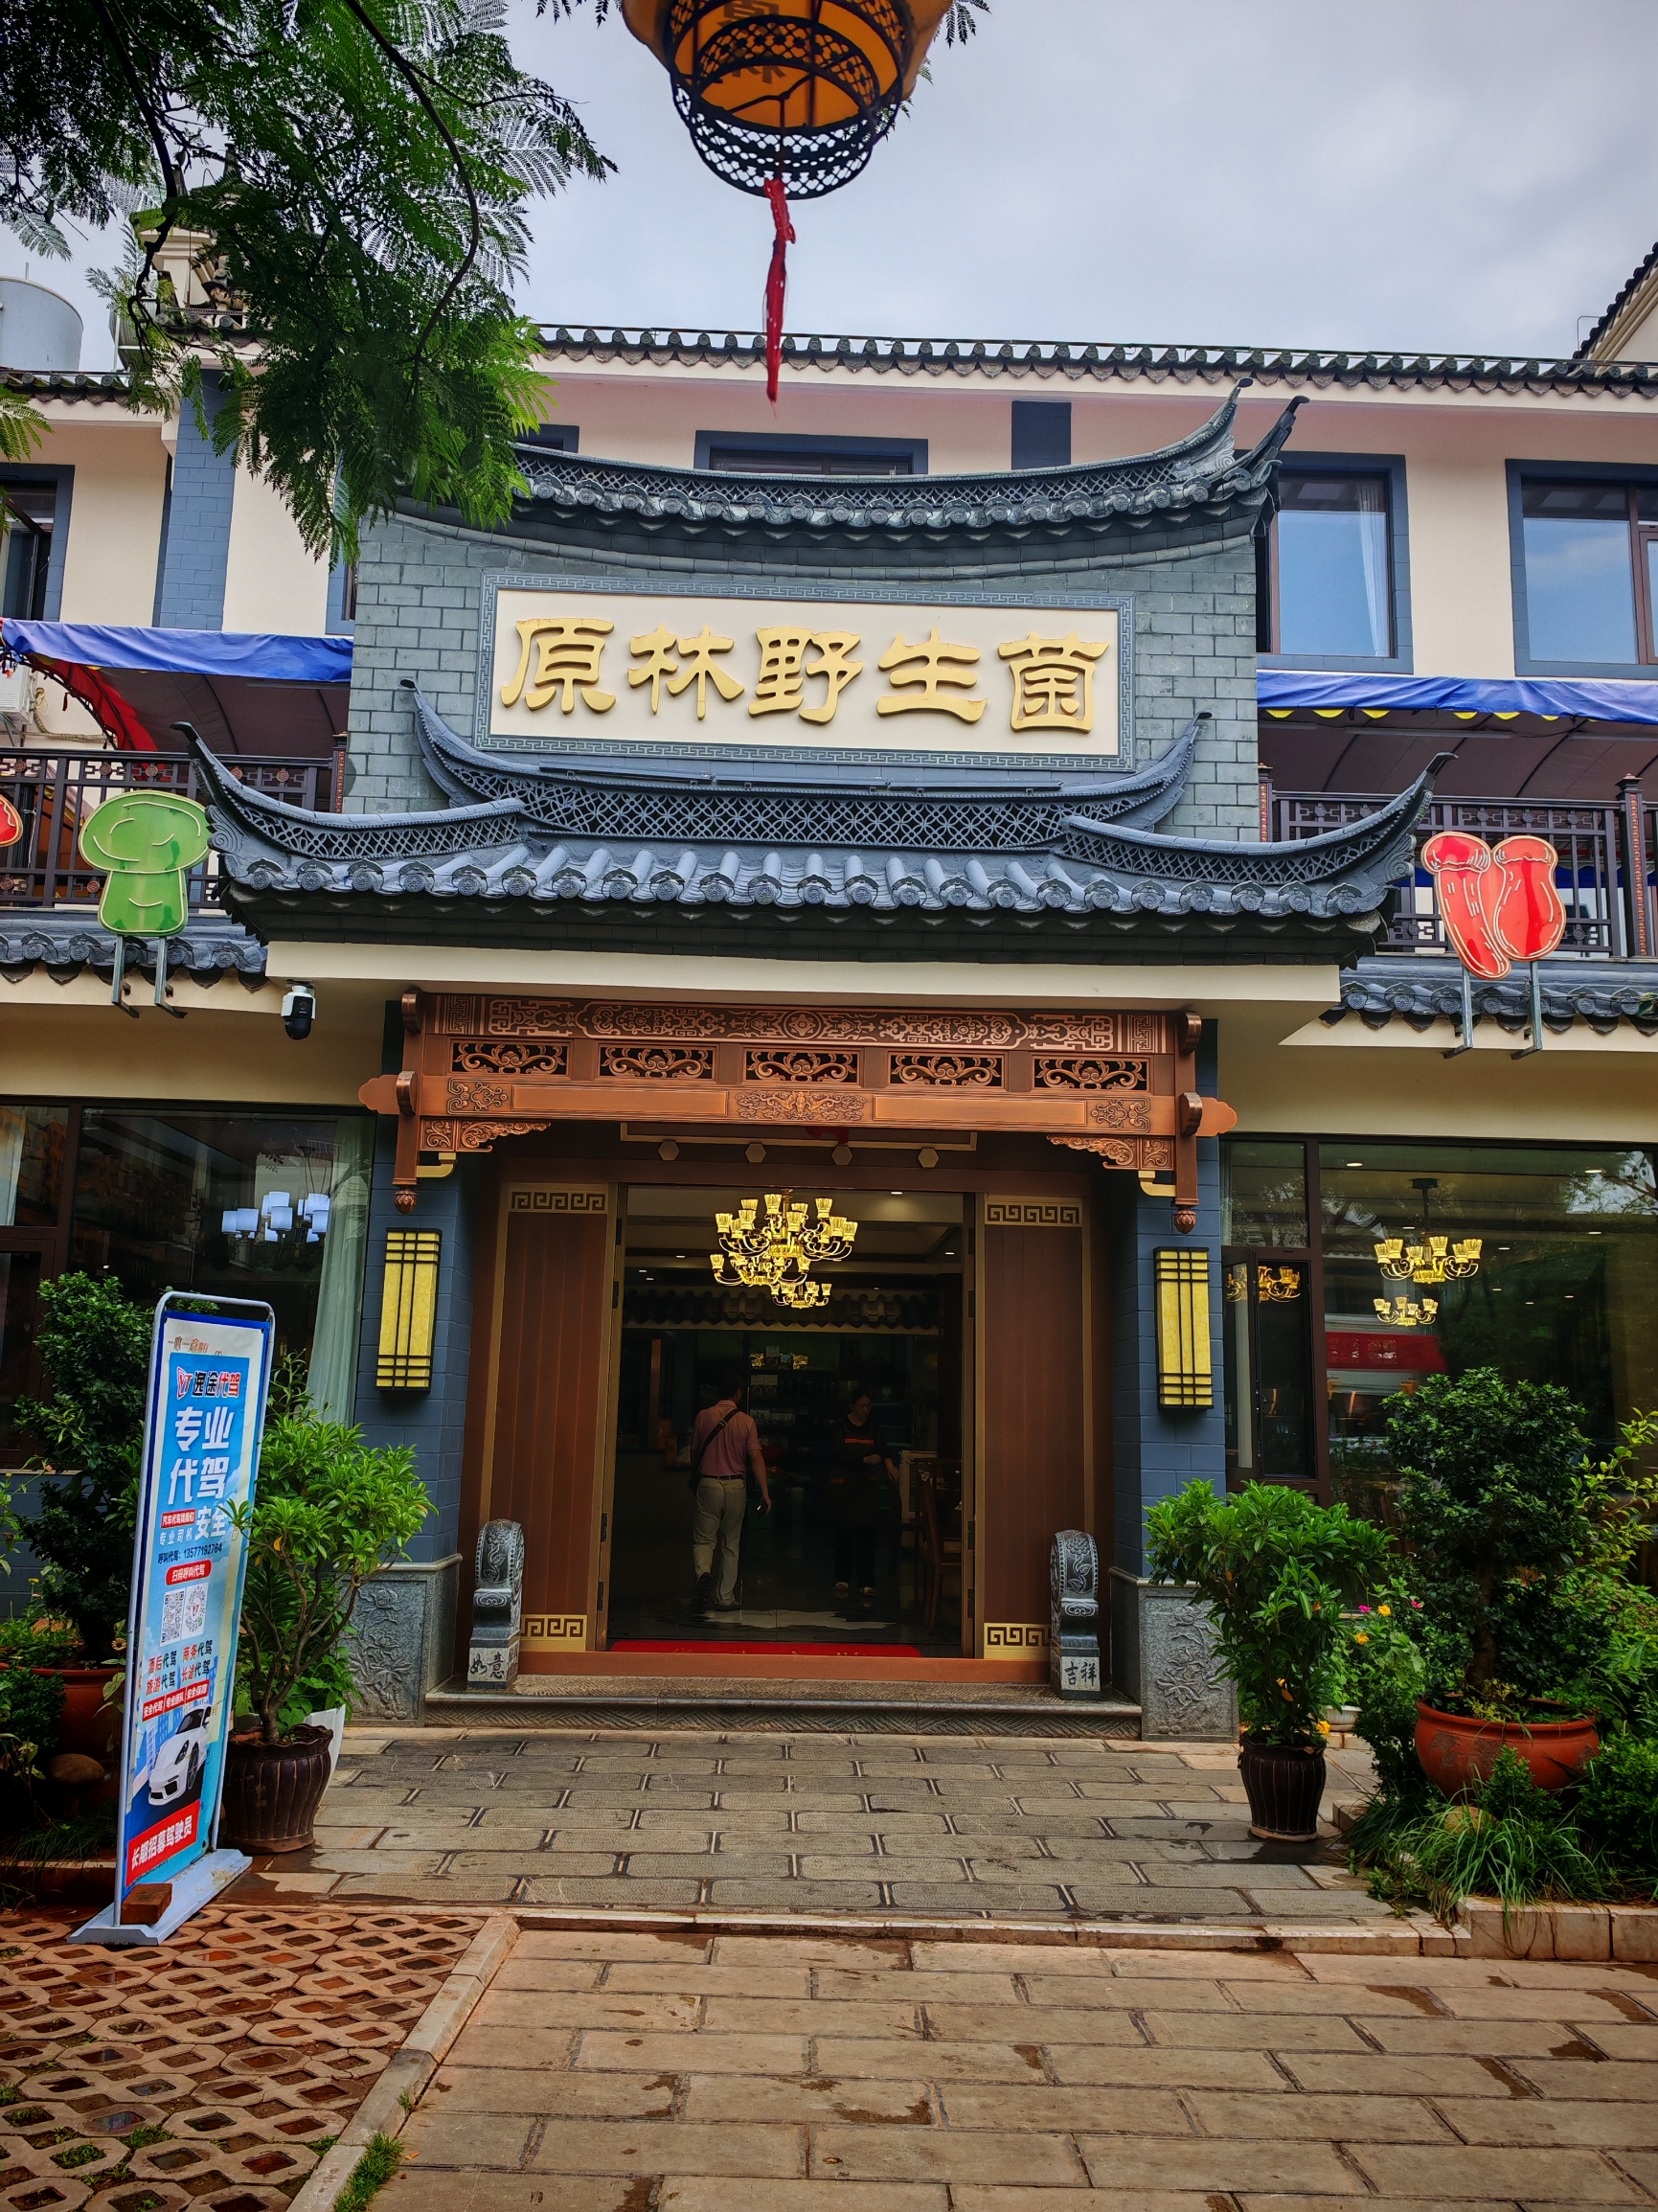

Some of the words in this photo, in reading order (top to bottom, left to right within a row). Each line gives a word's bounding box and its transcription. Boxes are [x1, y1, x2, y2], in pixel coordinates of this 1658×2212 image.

[500, 617, 1110, 734] 原林野生菌
[174, 1406, 234, 1451] 专业
[168, 1456, 230, 1505] 代驾
[159, 1527, 193, 1546] 专业司机
[195, 1504, 227, 1540] 安全
[148, 1651, 177, 1675] 酒后代驾
[183, 1640, 213, 1663] 商务代驾
[469, 1652, 505, 1679] 如意
[1064, 1660, 1098, 1687] 吉祥
[146, 1671, 175, 1696] 旅游代驾
[181, 1659, 211, 1683] 长途代驾
[131, 1814, 193, 1871] 长期招募驾驶员
